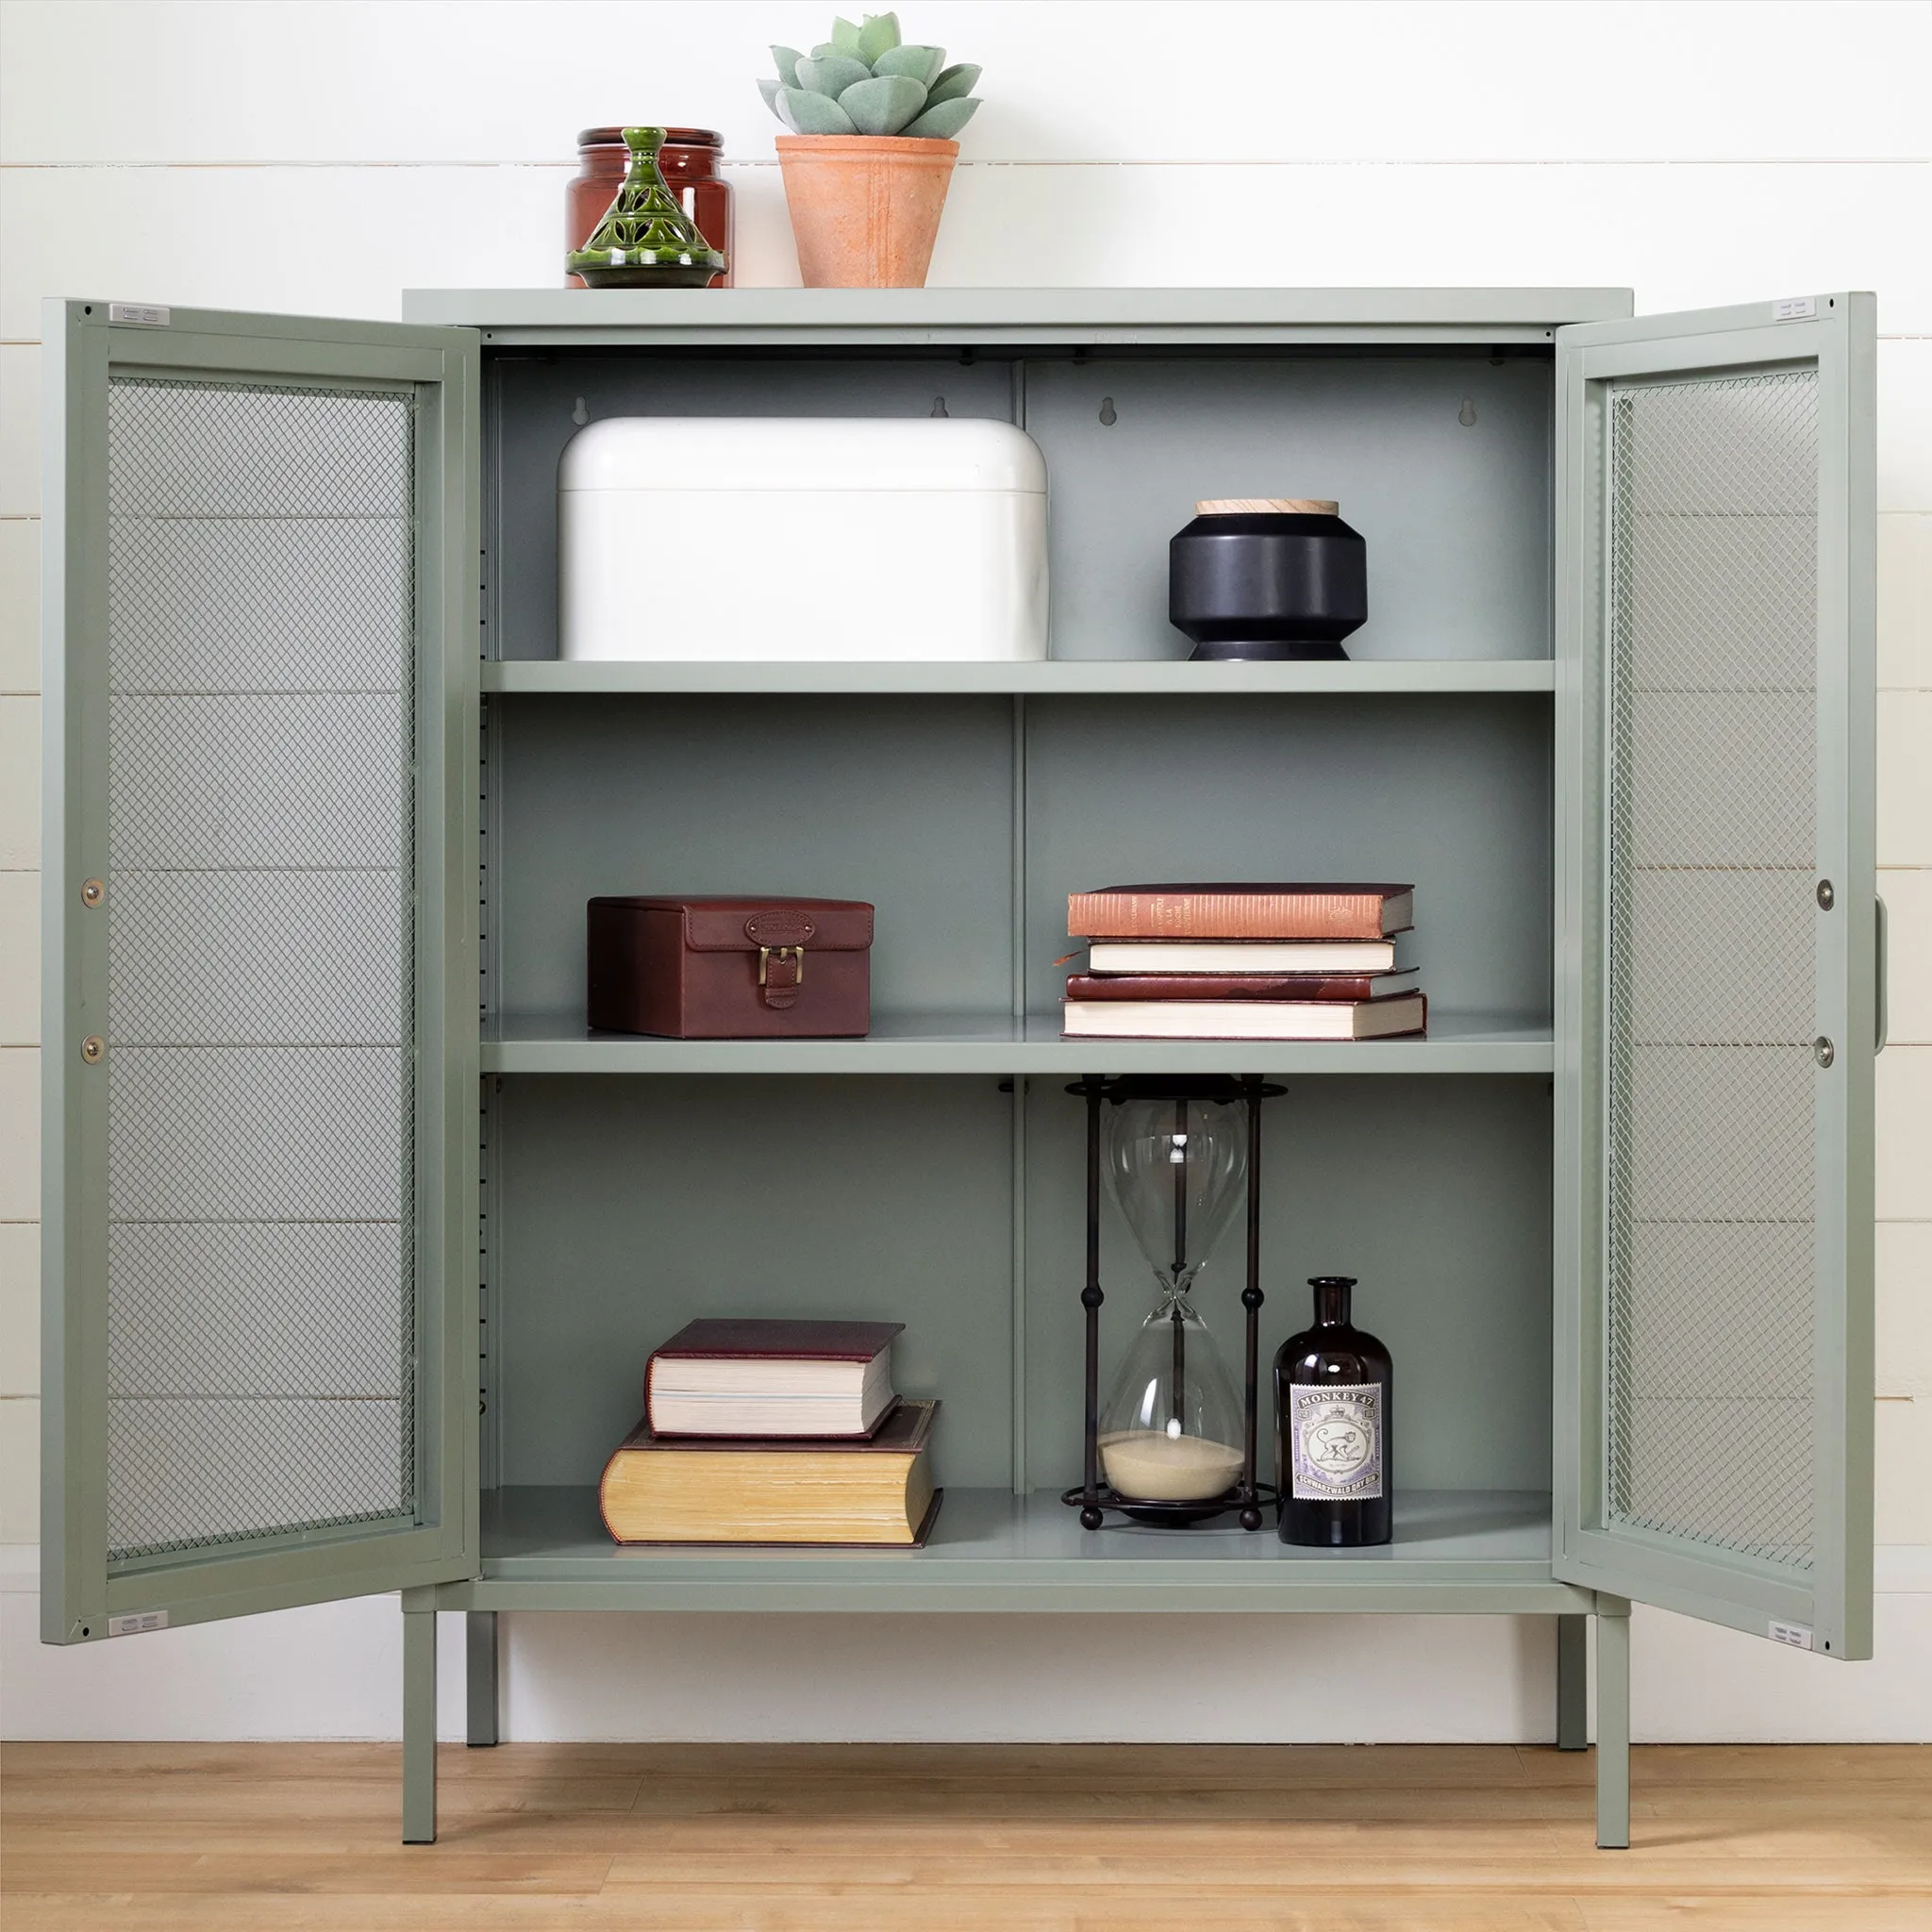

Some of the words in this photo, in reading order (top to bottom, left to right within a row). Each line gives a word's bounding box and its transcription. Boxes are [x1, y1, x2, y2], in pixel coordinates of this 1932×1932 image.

[1301, 1391, 1357, 1407] MONKEY
[1360, 1396, 1374, 1407] 47
[1299, 1475, 1351, 1494] SCHWARZWALD
[1351, 1481, 1365, 1491] DRY
[1365, 1474, 1376, 1483] GIN
